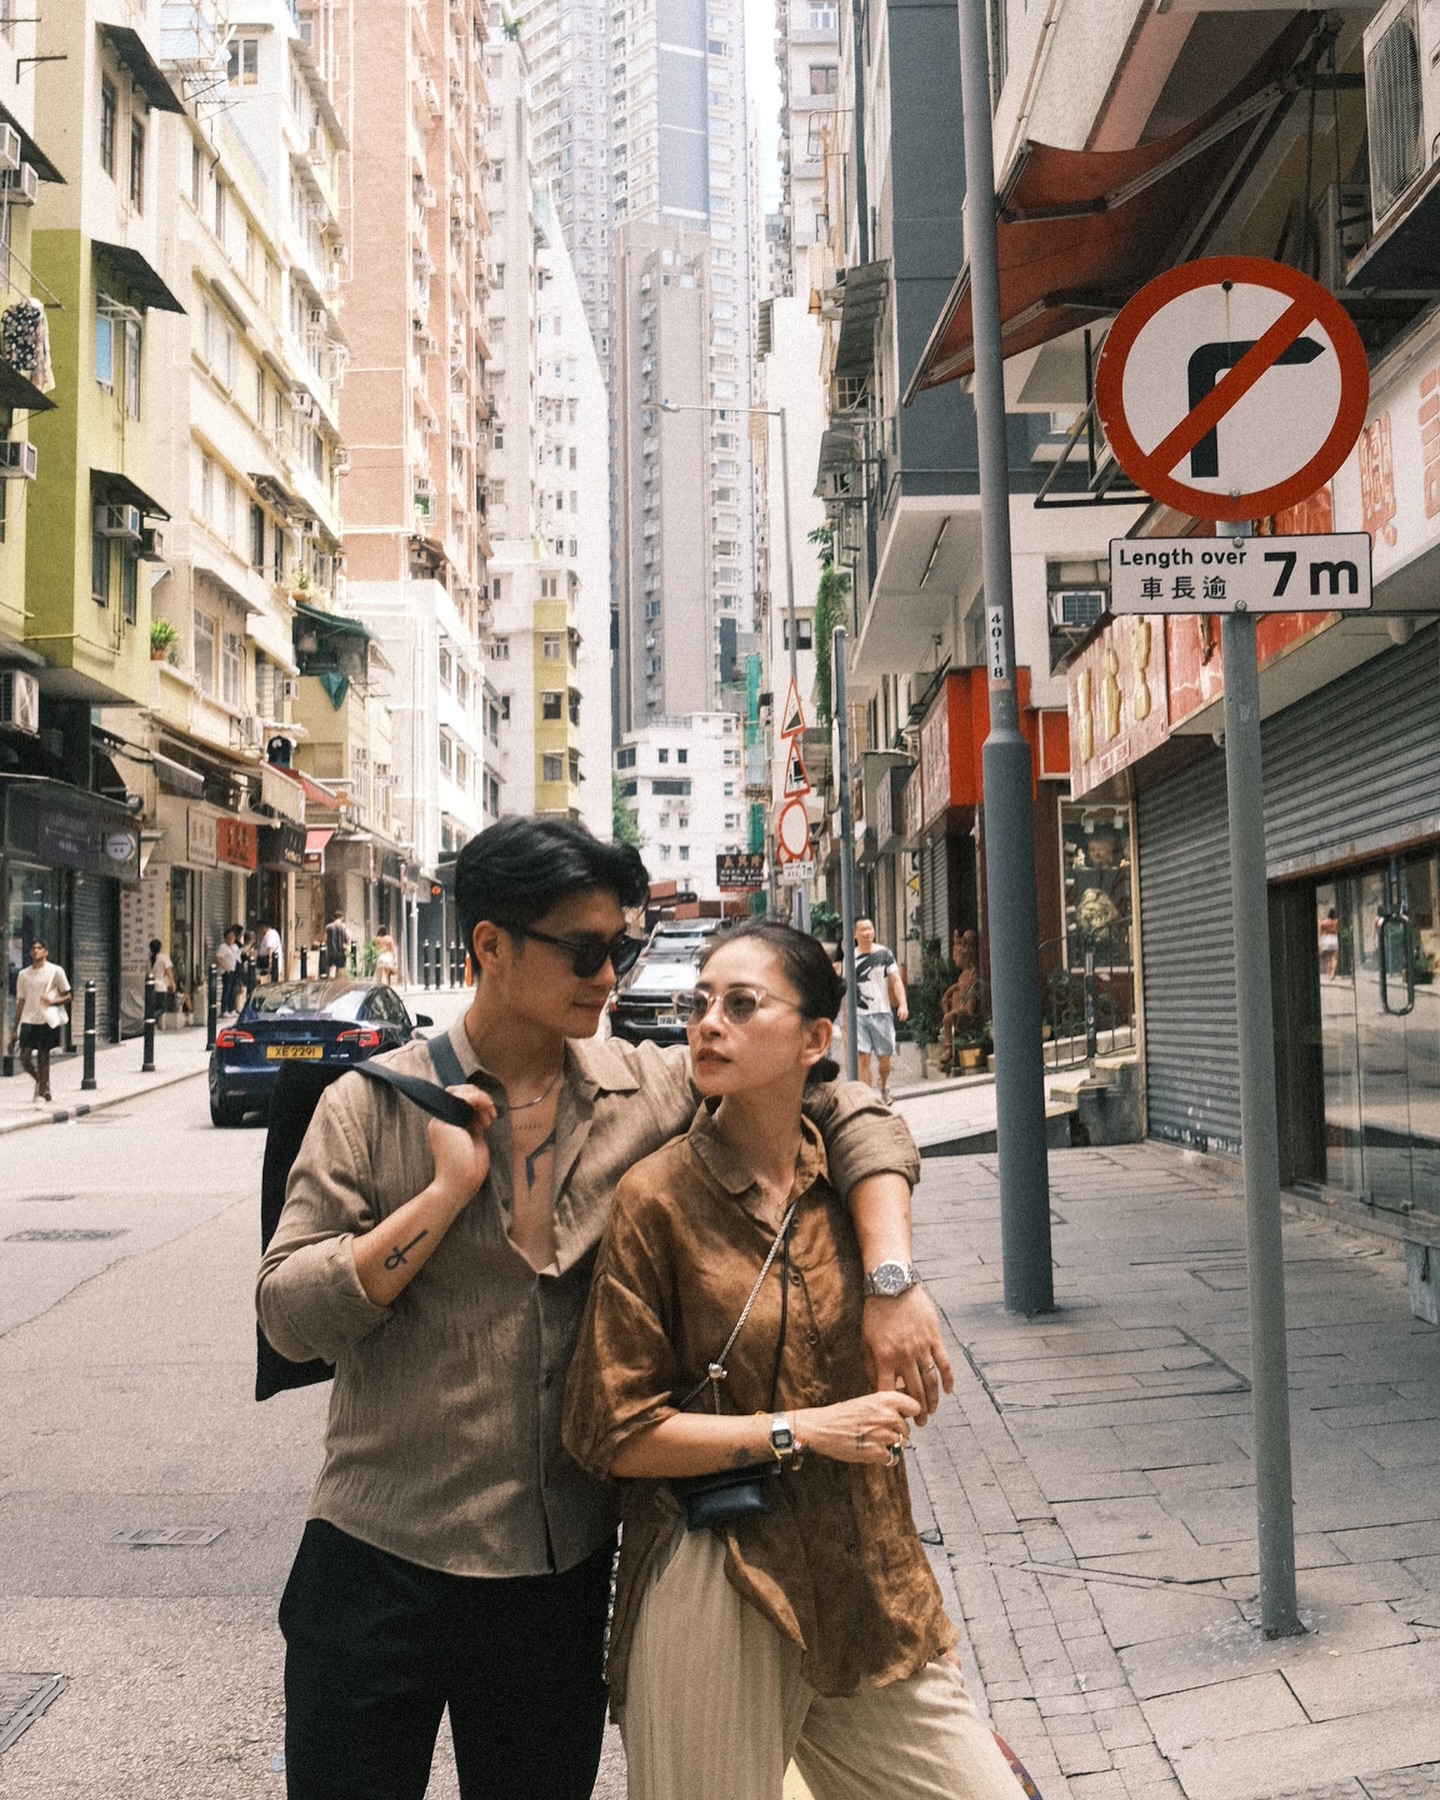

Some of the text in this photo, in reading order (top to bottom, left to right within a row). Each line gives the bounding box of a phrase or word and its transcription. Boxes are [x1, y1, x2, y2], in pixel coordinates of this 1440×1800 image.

[1119, 548, 1247, 569] Length over
[1140, 575, 1228, 600] 車長逾
[991, 613, 1004, 678] 40118
[275, 1046, 316, 1057] XE 2291
